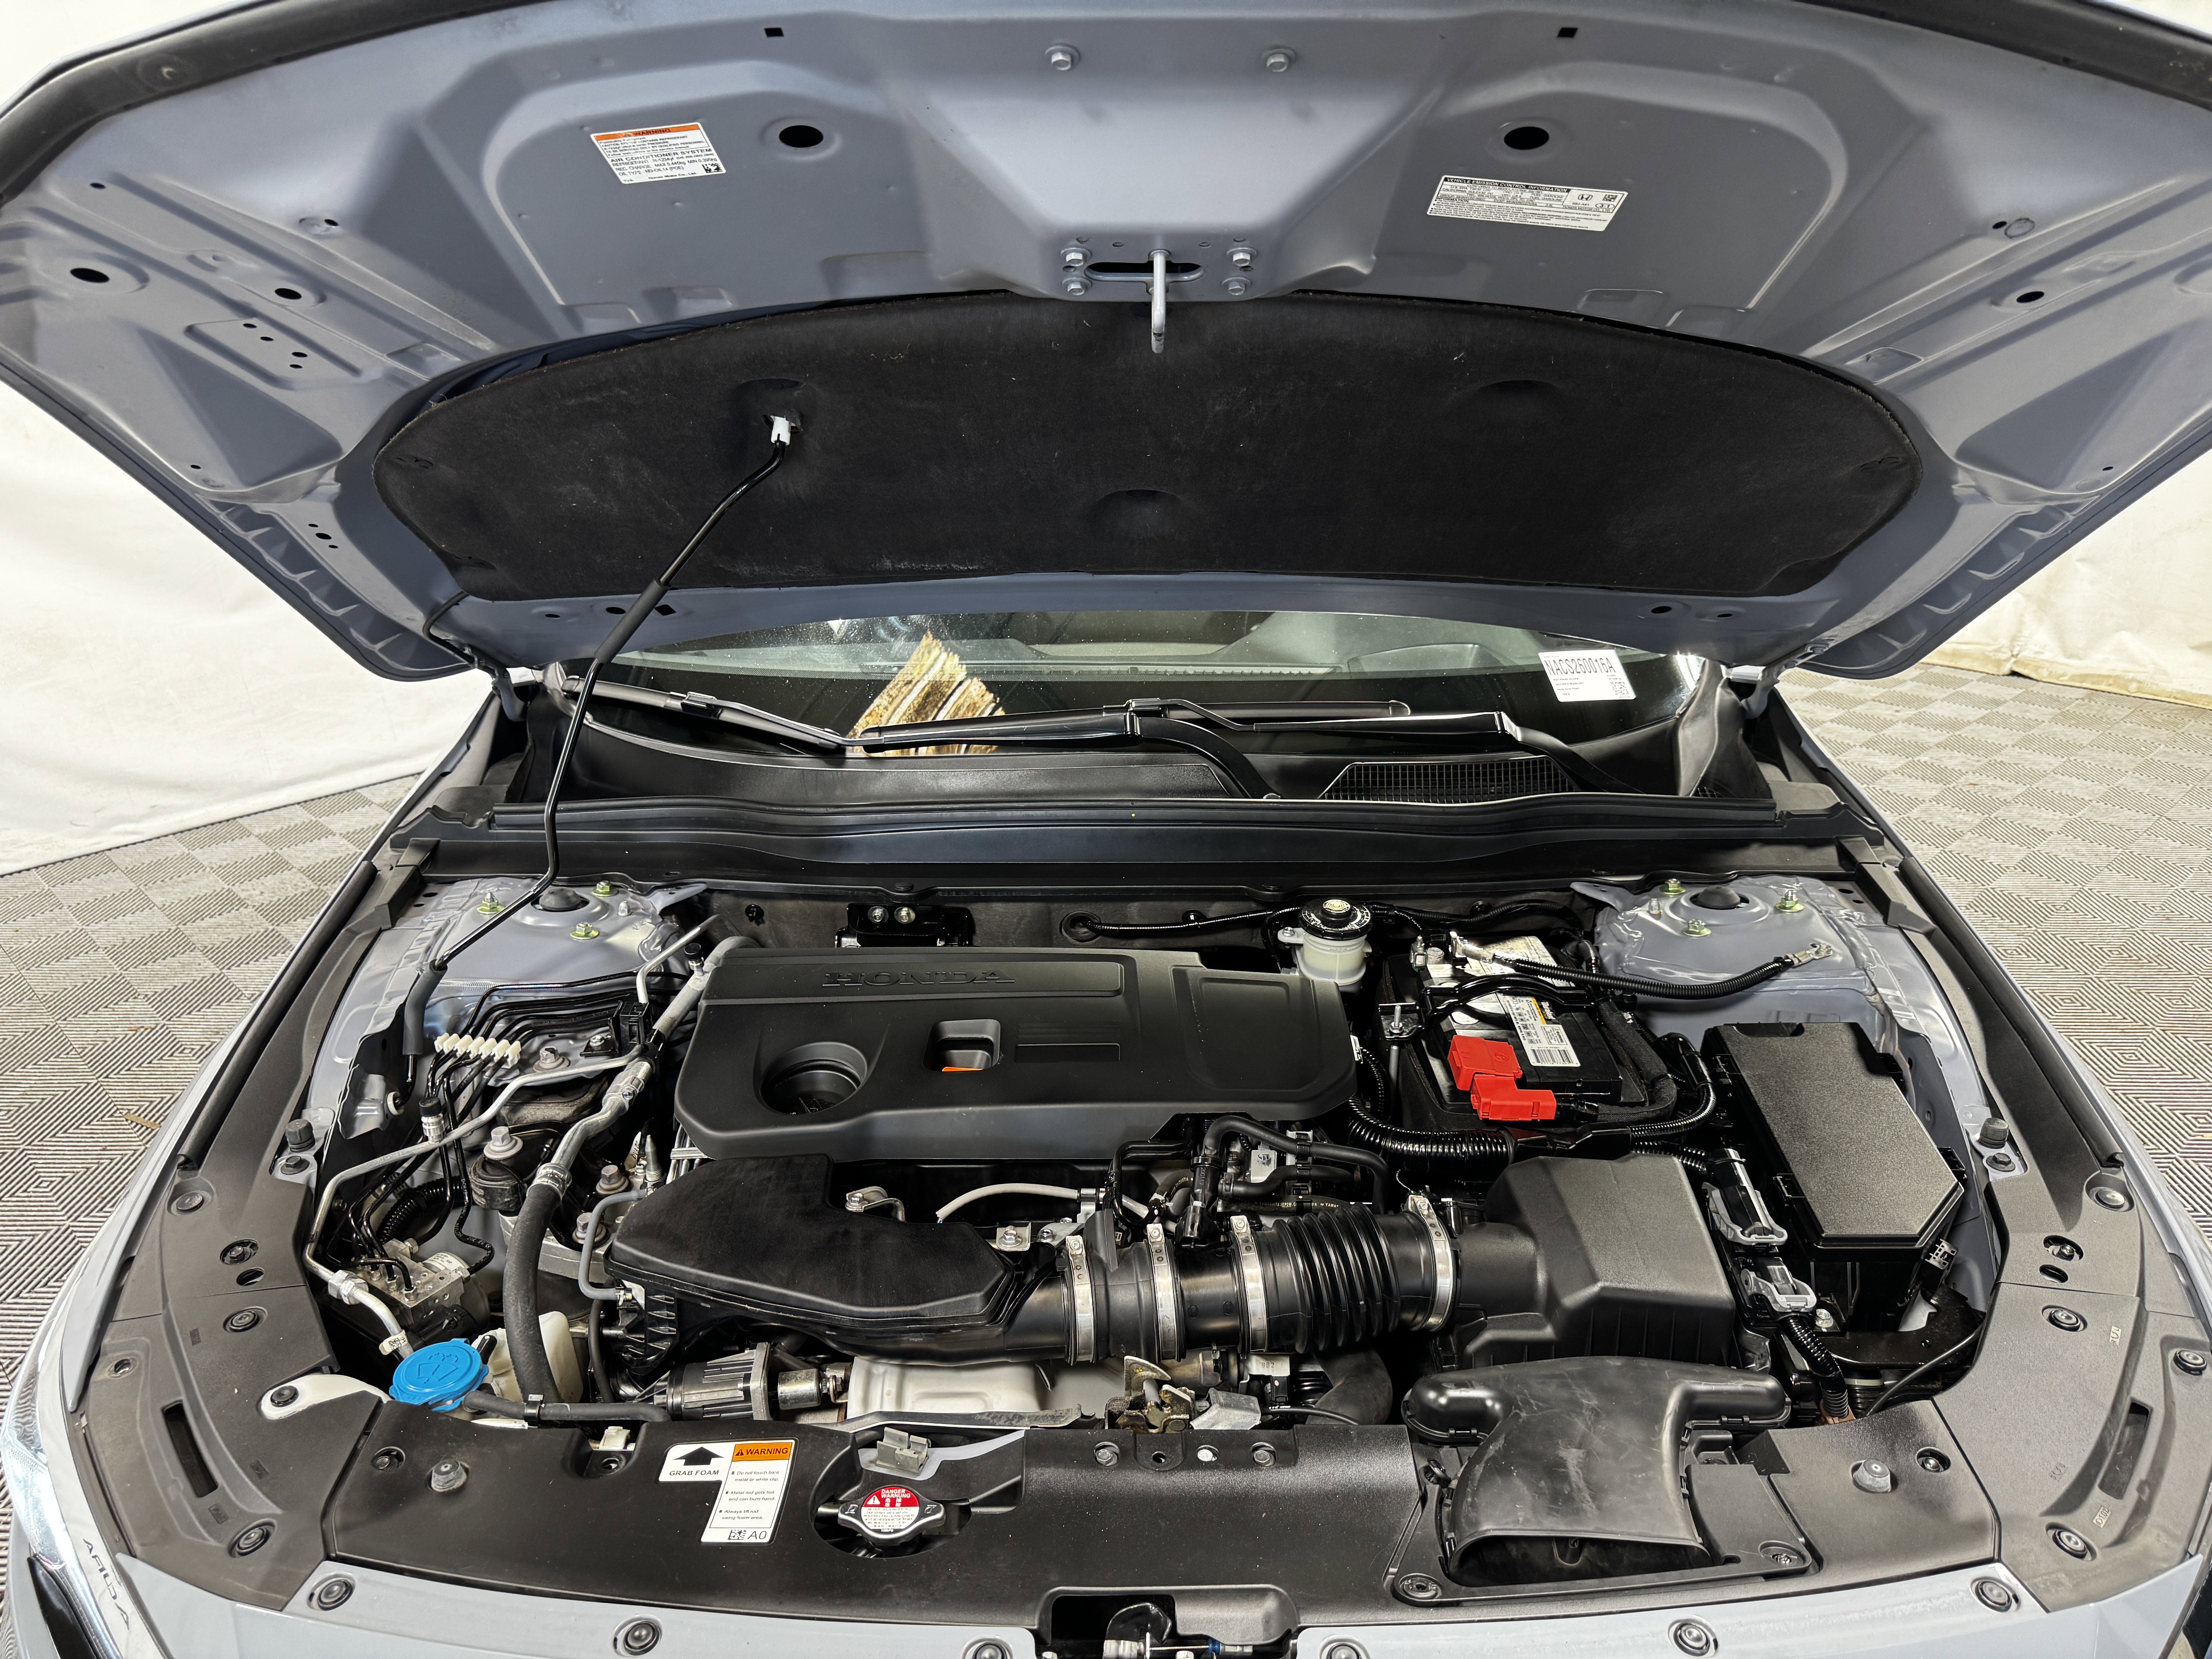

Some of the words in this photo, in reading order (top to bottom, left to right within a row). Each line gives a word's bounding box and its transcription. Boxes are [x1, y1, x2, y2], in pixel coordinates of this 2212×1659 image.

[625, 152, 679, 160] CONDITIONER
[1544, 658, 1616, 675] NACS260016A
[822, 970, 1015, 987] HONDA
[747, 1530, 767, 1540] A0
